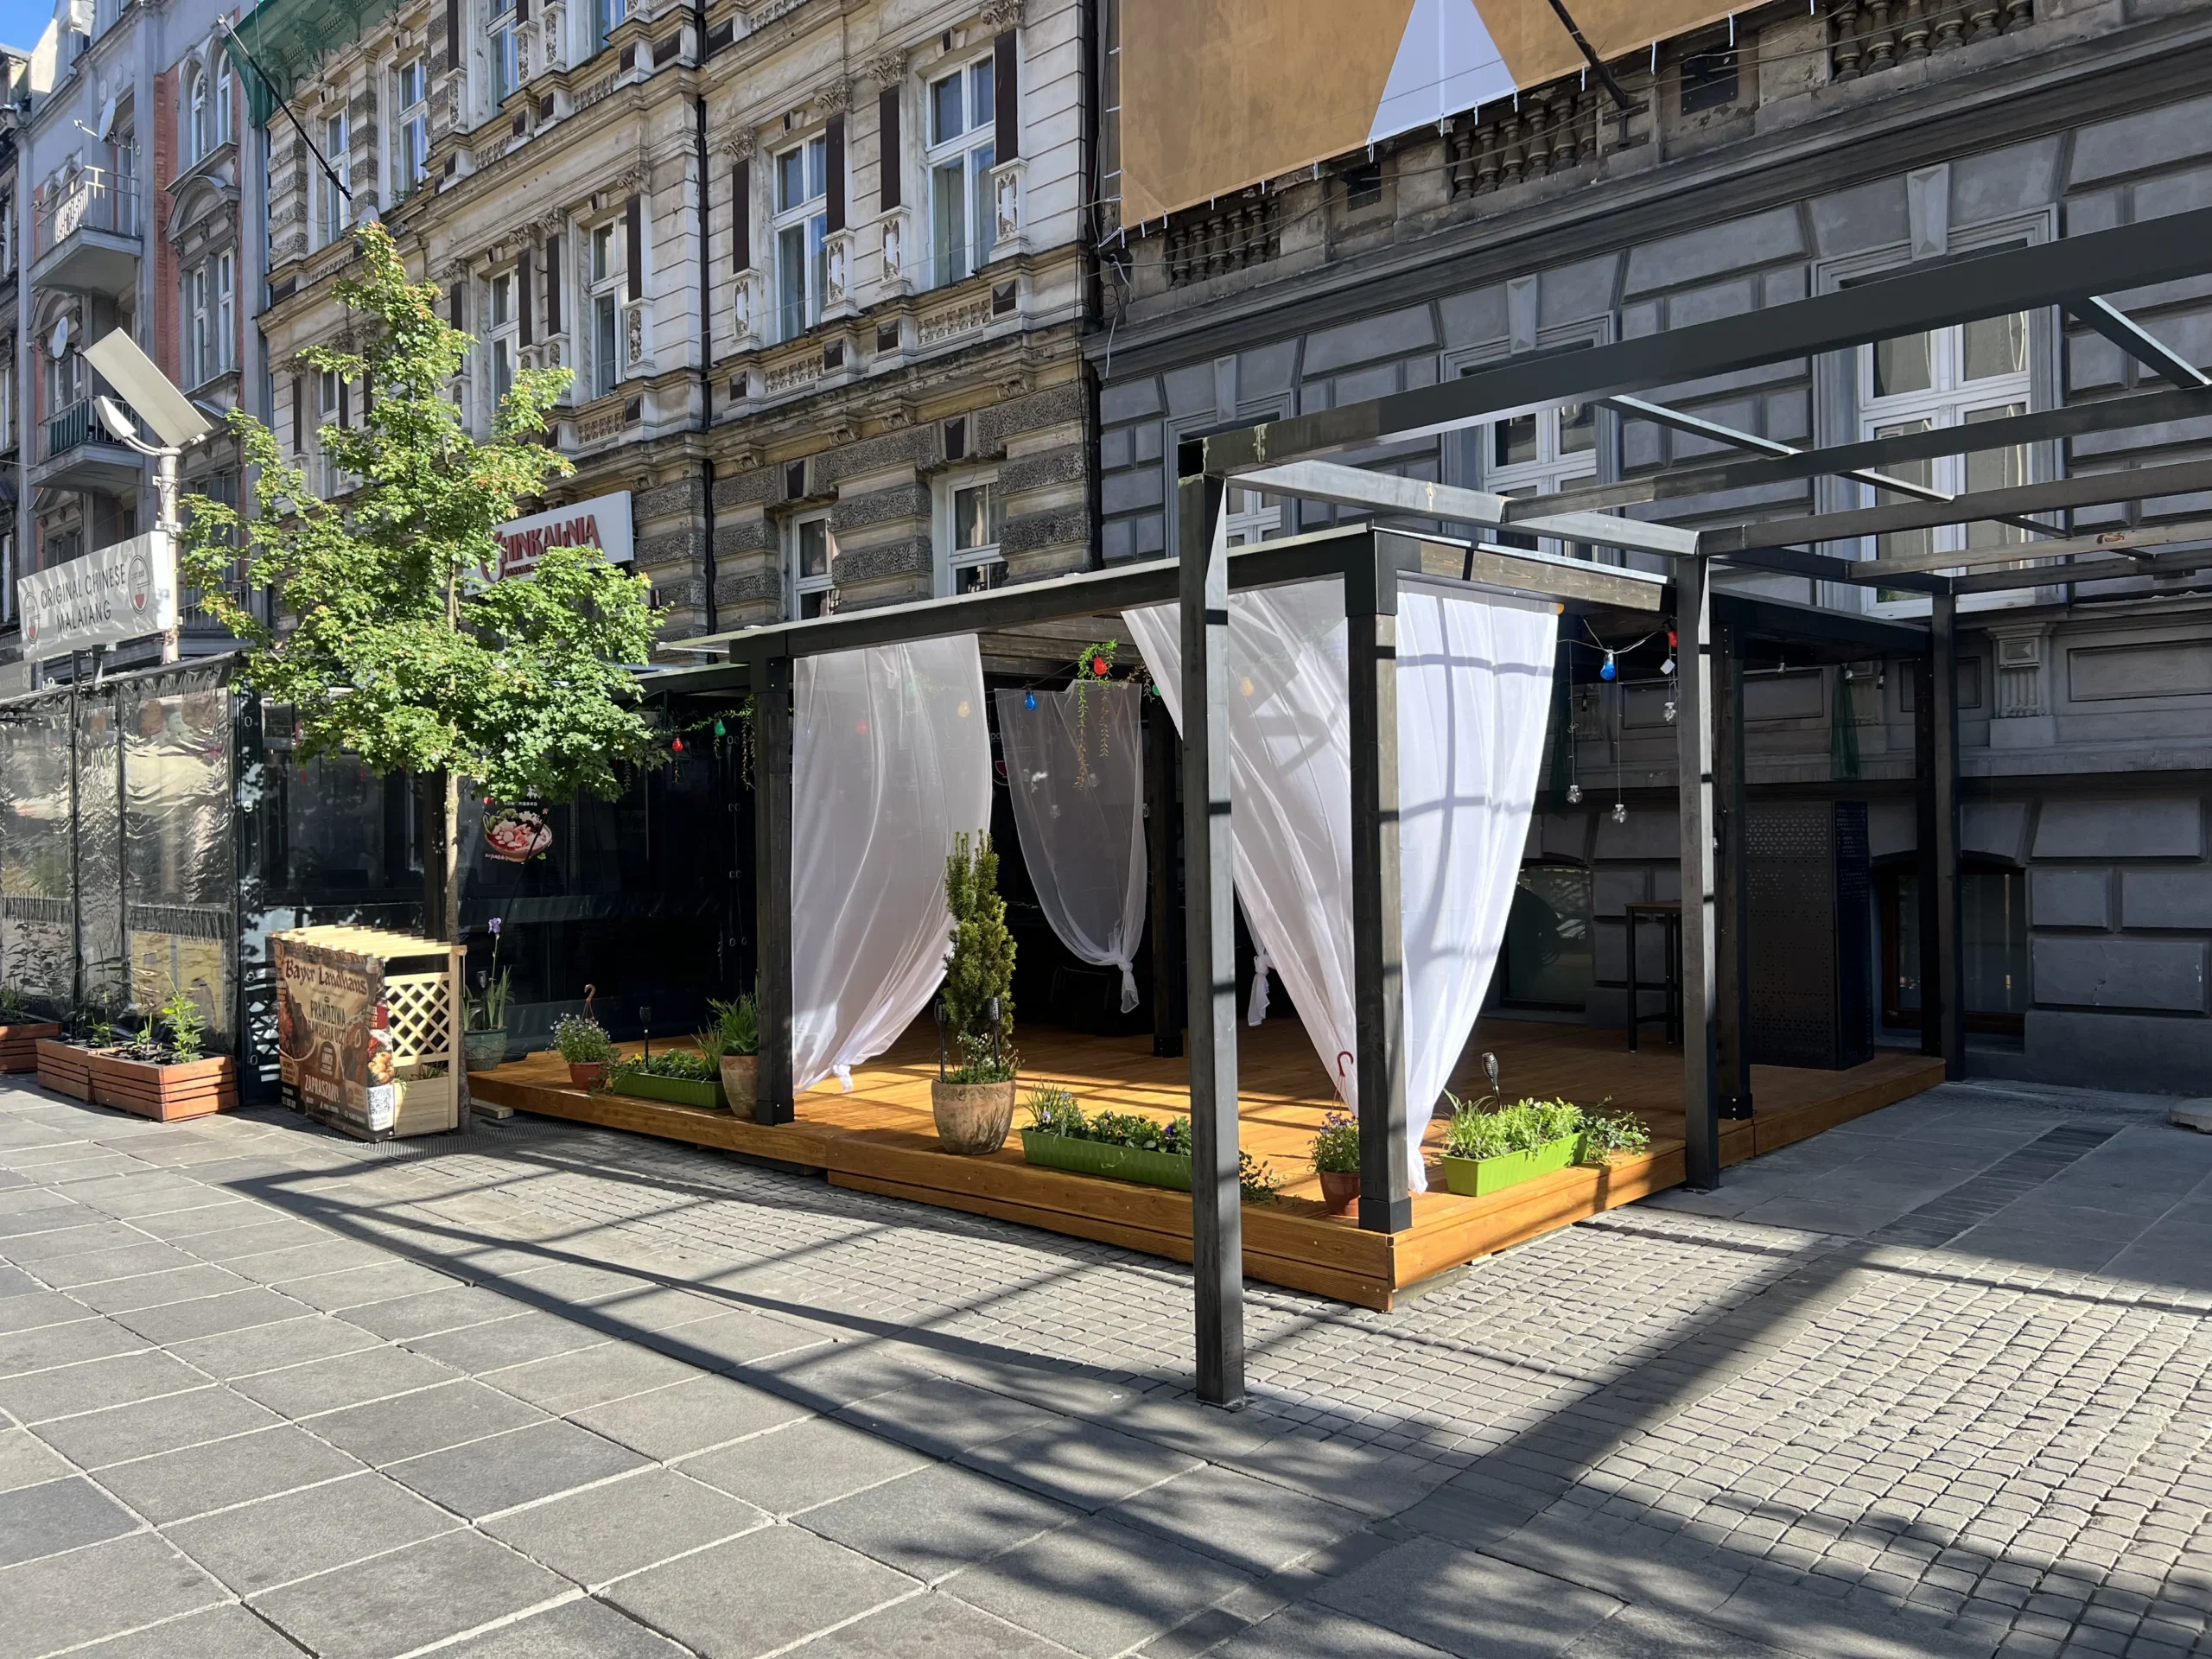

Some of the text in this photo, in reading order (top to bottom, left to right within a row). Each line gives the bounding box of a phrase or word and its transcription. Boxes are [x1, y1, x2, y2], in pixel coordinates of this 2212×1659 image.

[41, 563, 126, 609] ORIGINAL CHINESE
[56, 600, 111, 633] MALATANG
[285, 958, 315, 986] Bayer
[318, 965, 367, 995] Landhaus
[310, 999, 346, 1027] PRAWDZIWA
